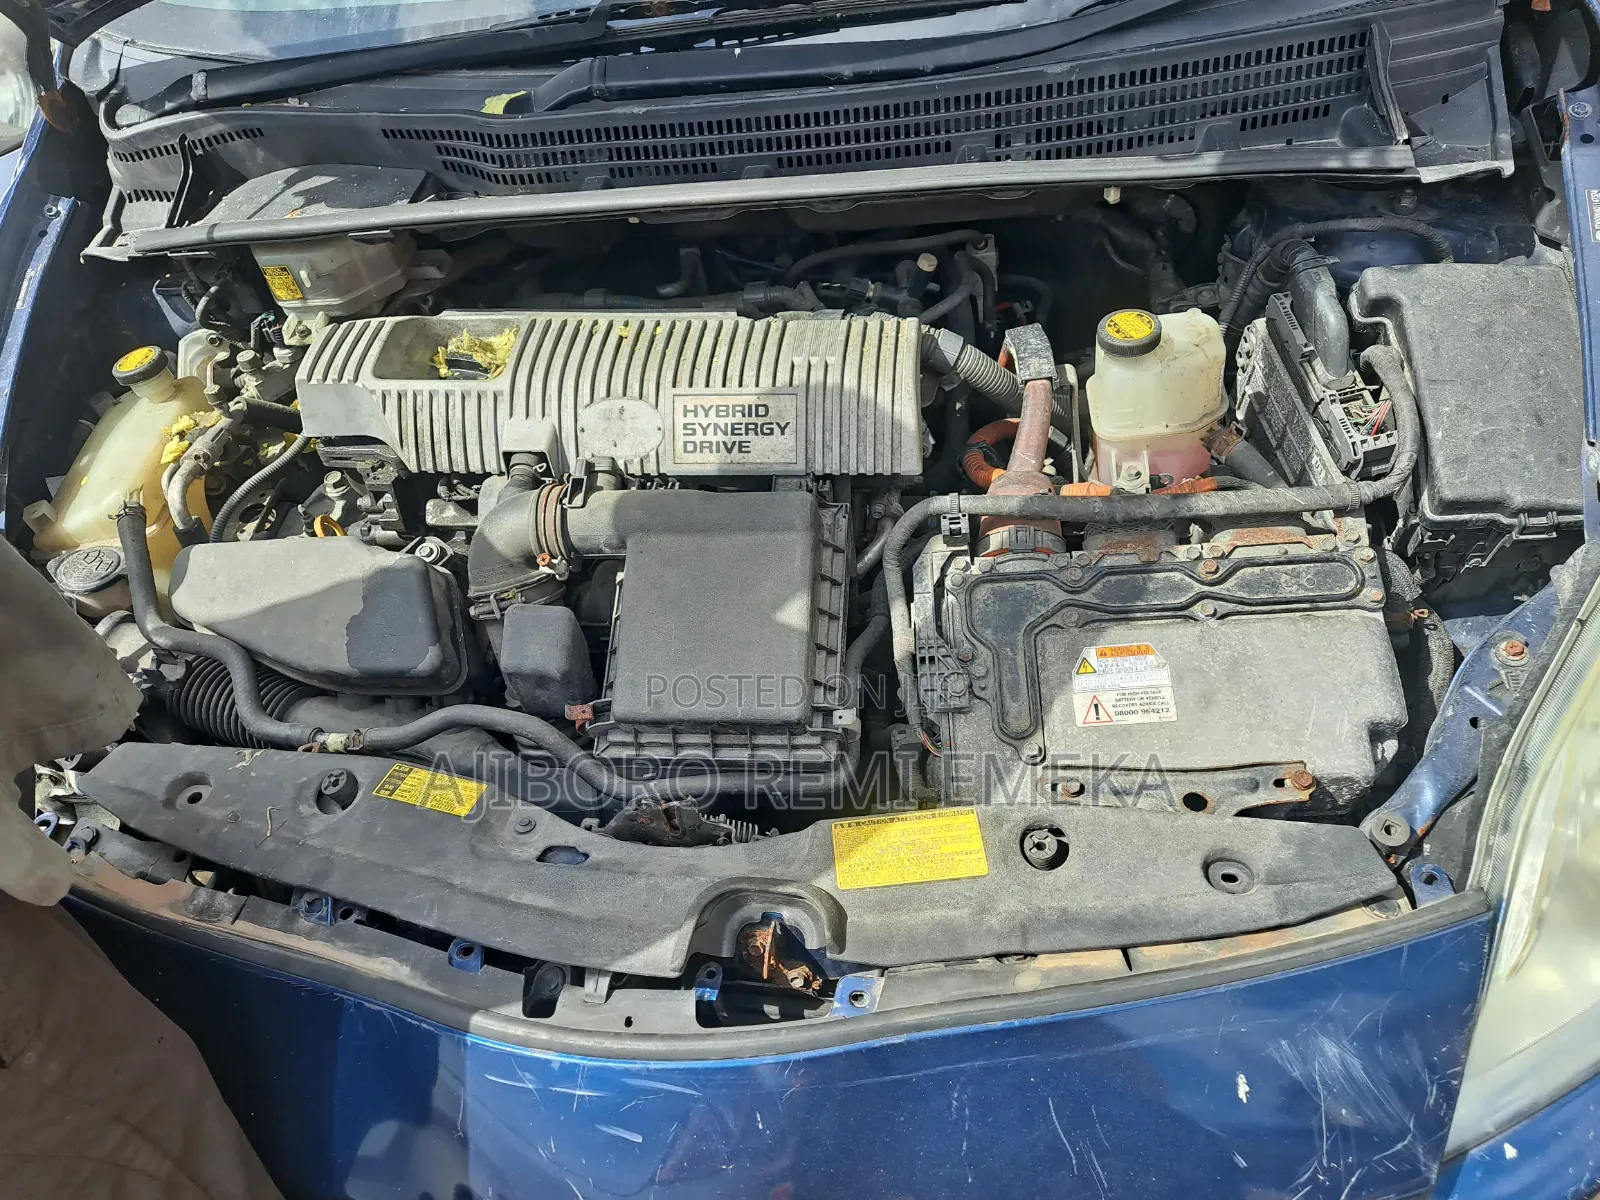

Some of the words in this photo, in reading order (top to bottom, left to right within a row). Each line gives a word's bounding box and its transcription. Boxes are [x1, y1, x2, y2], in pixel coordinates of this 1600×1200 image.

[683, 404, 770, 418] HYBRID
[682, 422, 791, 436] SYNERGY
[683, 440, 752, 454] DRIVE
[1114, 709, 1139, 717] 08000
[1140, 707, 1170, 715] 964212
